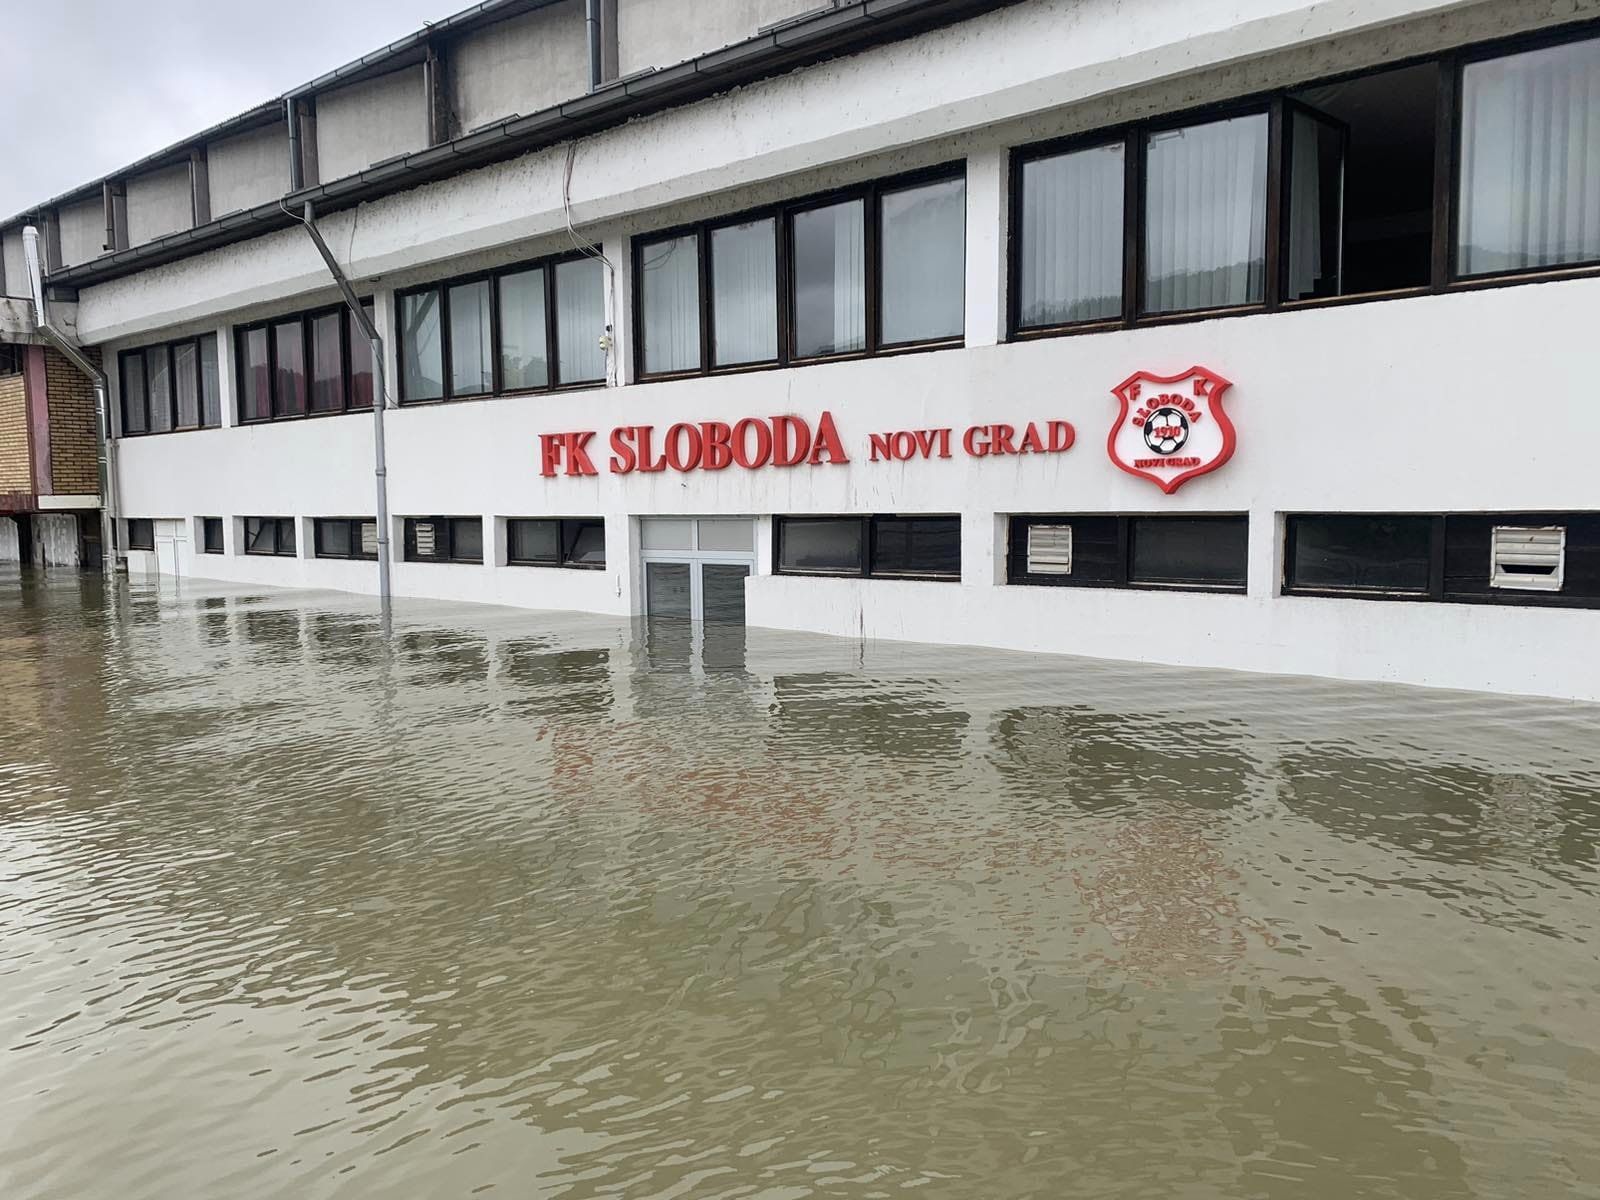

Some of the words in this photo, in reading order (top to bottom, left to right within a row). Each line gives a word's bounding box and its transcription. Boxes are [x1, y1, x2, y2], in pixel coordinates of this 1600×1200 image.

[1129, 383, 1141, 401] F
[1193, 378, 1209, 396] K
[1131, 393, 1203, 428] SLOBODA
[539, 431, 599, 478] FK
[608, 410, 849, 475] SLOBODA
[869, 428, 952, 462] NOVI
[963, 420, 1076, 457] GRAD
[1134, 458, 1165, 468] NOVI
[1166, 457, 1201, 467] GRAD
